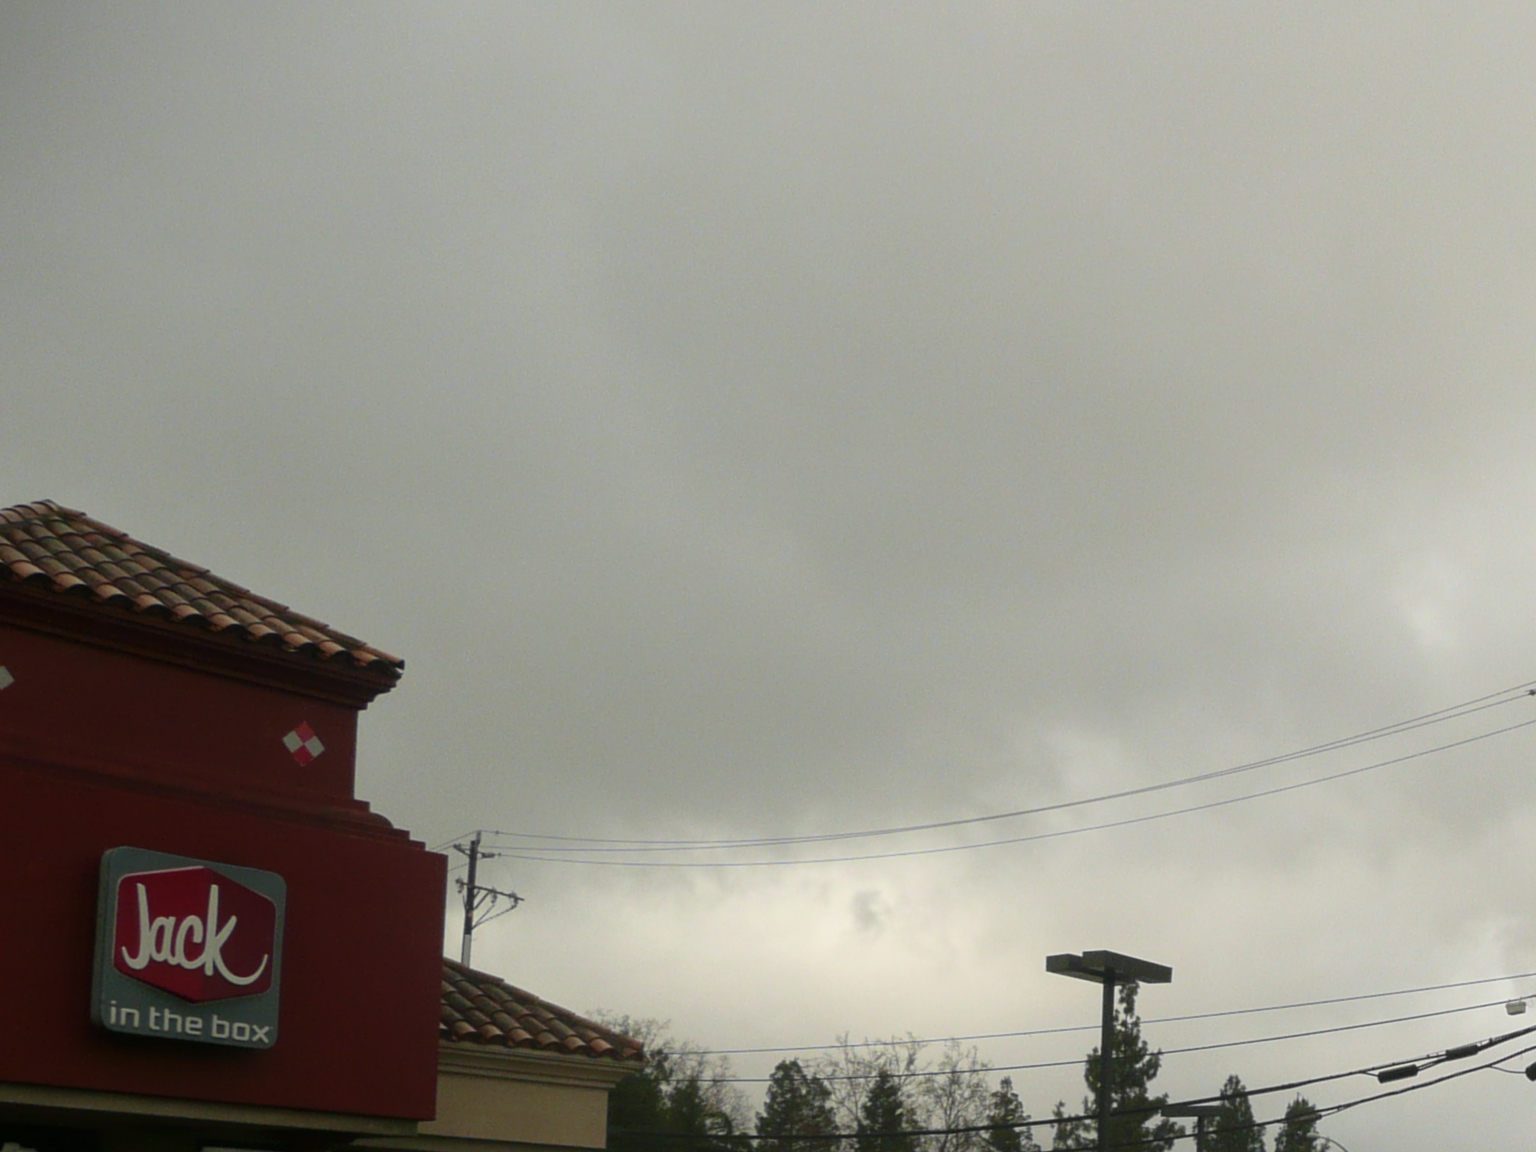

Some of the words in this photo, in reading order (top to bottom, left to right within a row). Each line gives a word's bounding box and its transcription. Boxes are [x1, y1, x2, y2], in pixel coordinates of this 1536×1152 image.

[121, 882, 269, 986] Jack
[109, 1000, 140, 1028] in
[149, 1006, 204, 1036] the
[211, 1014, 270, 1044] box
